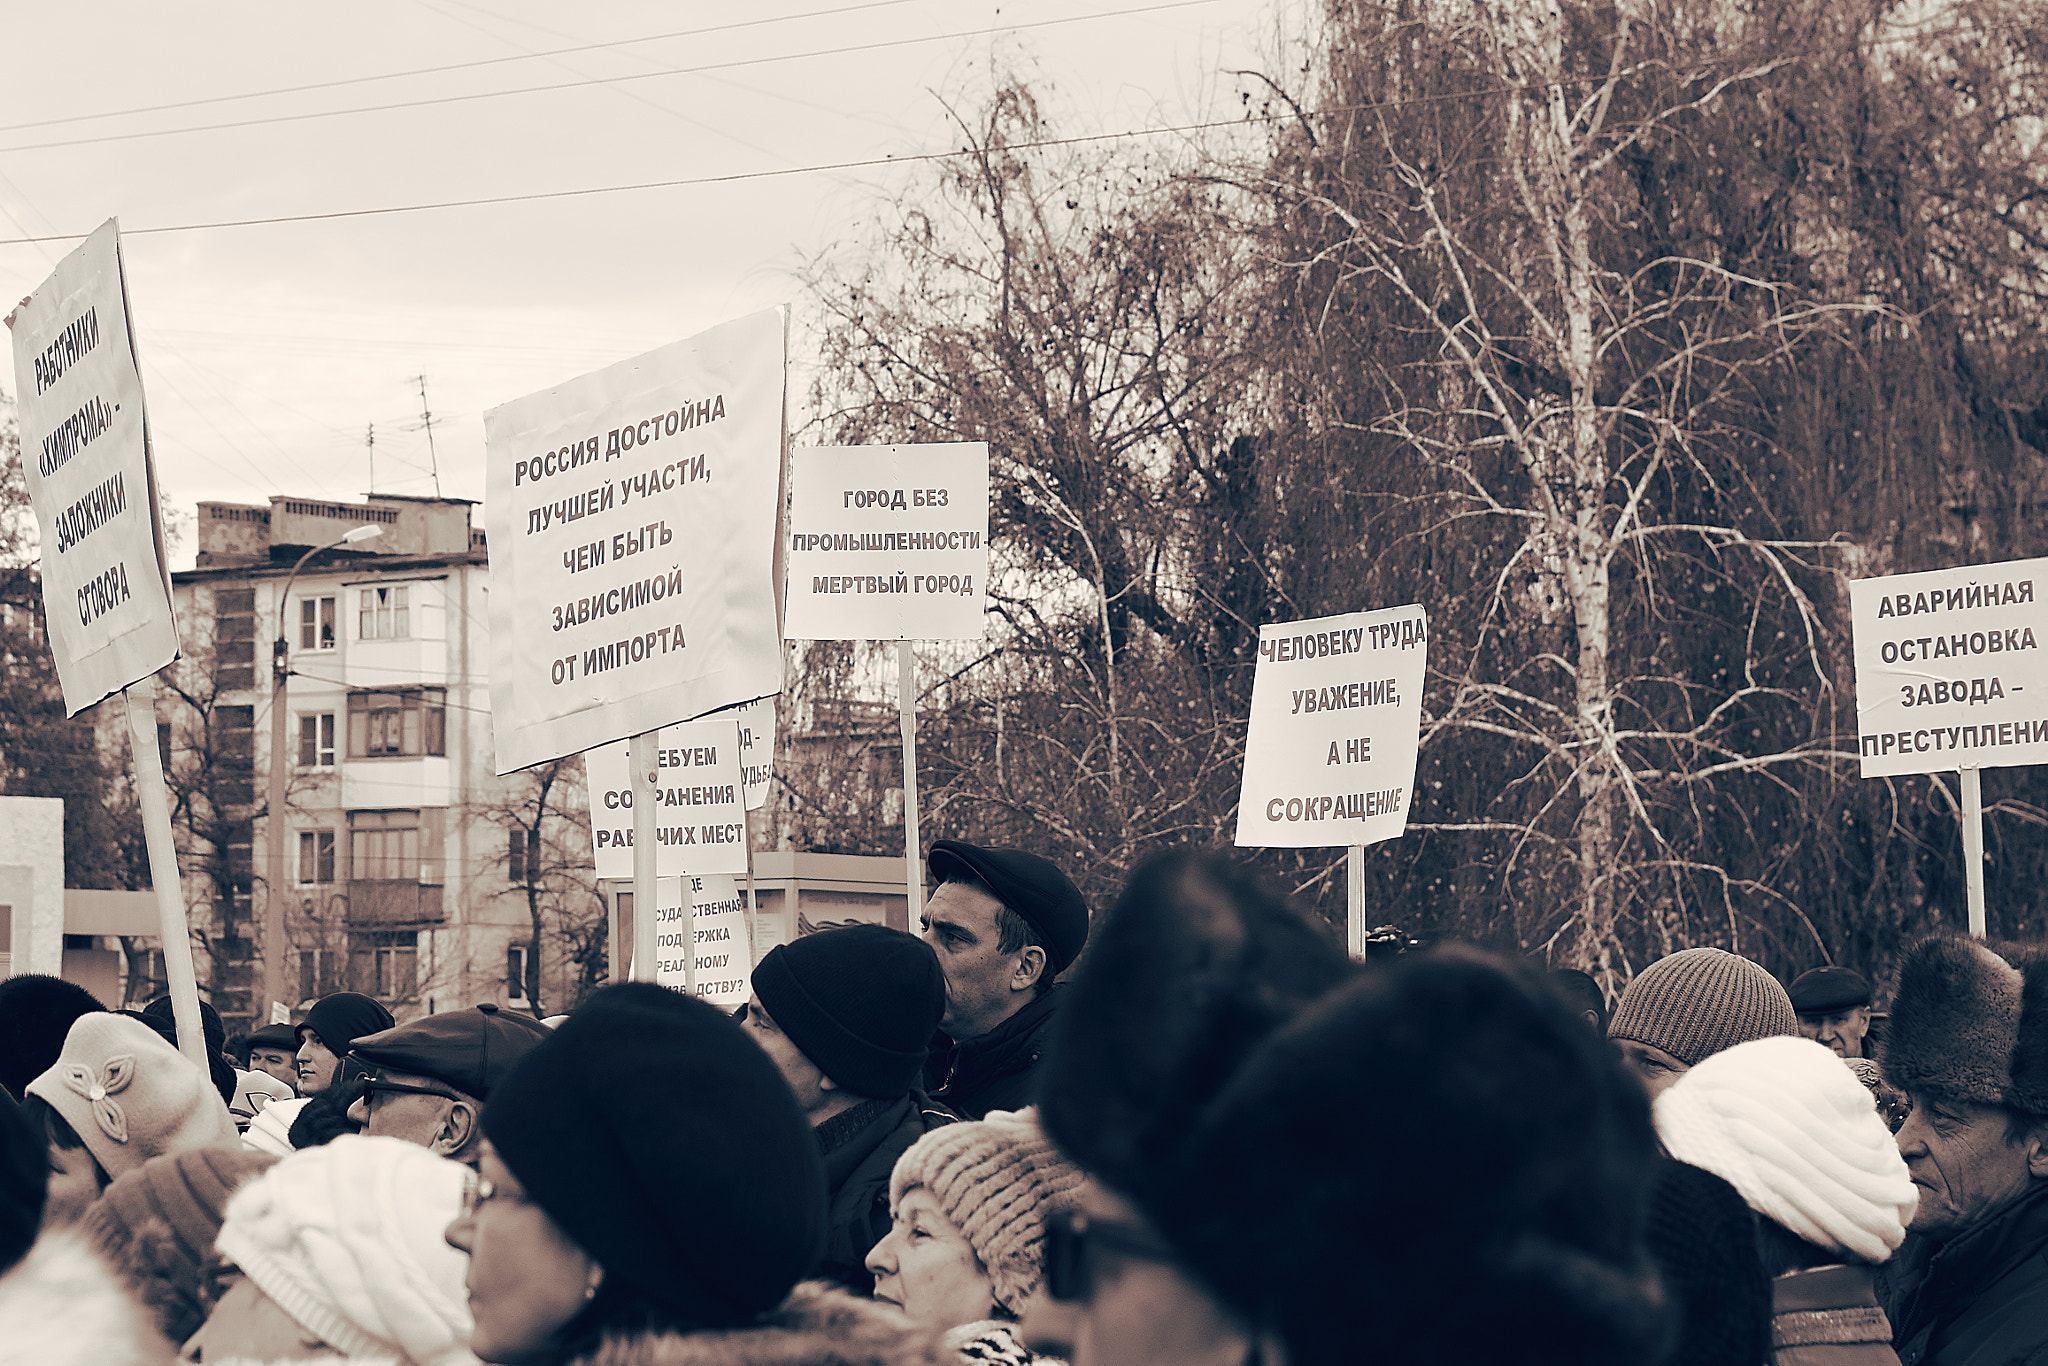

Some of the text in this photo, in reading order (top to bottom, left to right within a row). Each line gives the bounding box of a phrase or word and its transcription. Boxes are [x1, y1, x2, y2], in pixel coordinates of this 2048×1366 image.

[34, 305, 100, 397] РАБОТНИКИ
[38, 394, 112, 478] «ХИМПРОМА»
[515, 394, 727, 488] РОССИЯ ДОСТОЙНА
[55, 470, 128, 555] ЗАЛОЖНИКИ
[526, 452, 712, 536] ЛУЧШЕЙ УЧАСТИ,
[843, 488, 949, 511] ГОРОД БЕЗ
[563, 519, 673, 575] ЧЕМ БЫТЬ
[77, 561, 131, 627] СГОВОРА
[551, 563, 683, 633] ЗАВИСИМОЙ
[812, 570, 974, 597] МЕРТВЫЙ ГОРОД
[1877, 580, 2035, 619] АВАРИЙНАЯ
[550, 623, 687, 687] ОТ ИМПОРТА
[1259, 618, 1426, 663] ЧЕЛОВЕКУ ТРУДА
[1880, 627, 2038, 664] ОСТАНОВКА
[1291, 678, 1401, 715] УВАЖЕНИЕ,
[1900, 677, 2005, 707] ЗАВОДА
[1326, 737, 1371, 766] А НЕ
[1861, 719, 2048, 757] ПРЕСТУПЛЕНИ
[1266, 787, 1403, 822] СОКРАЩЕНИЕ
[701, 823, 744, 845] МЕСТ
